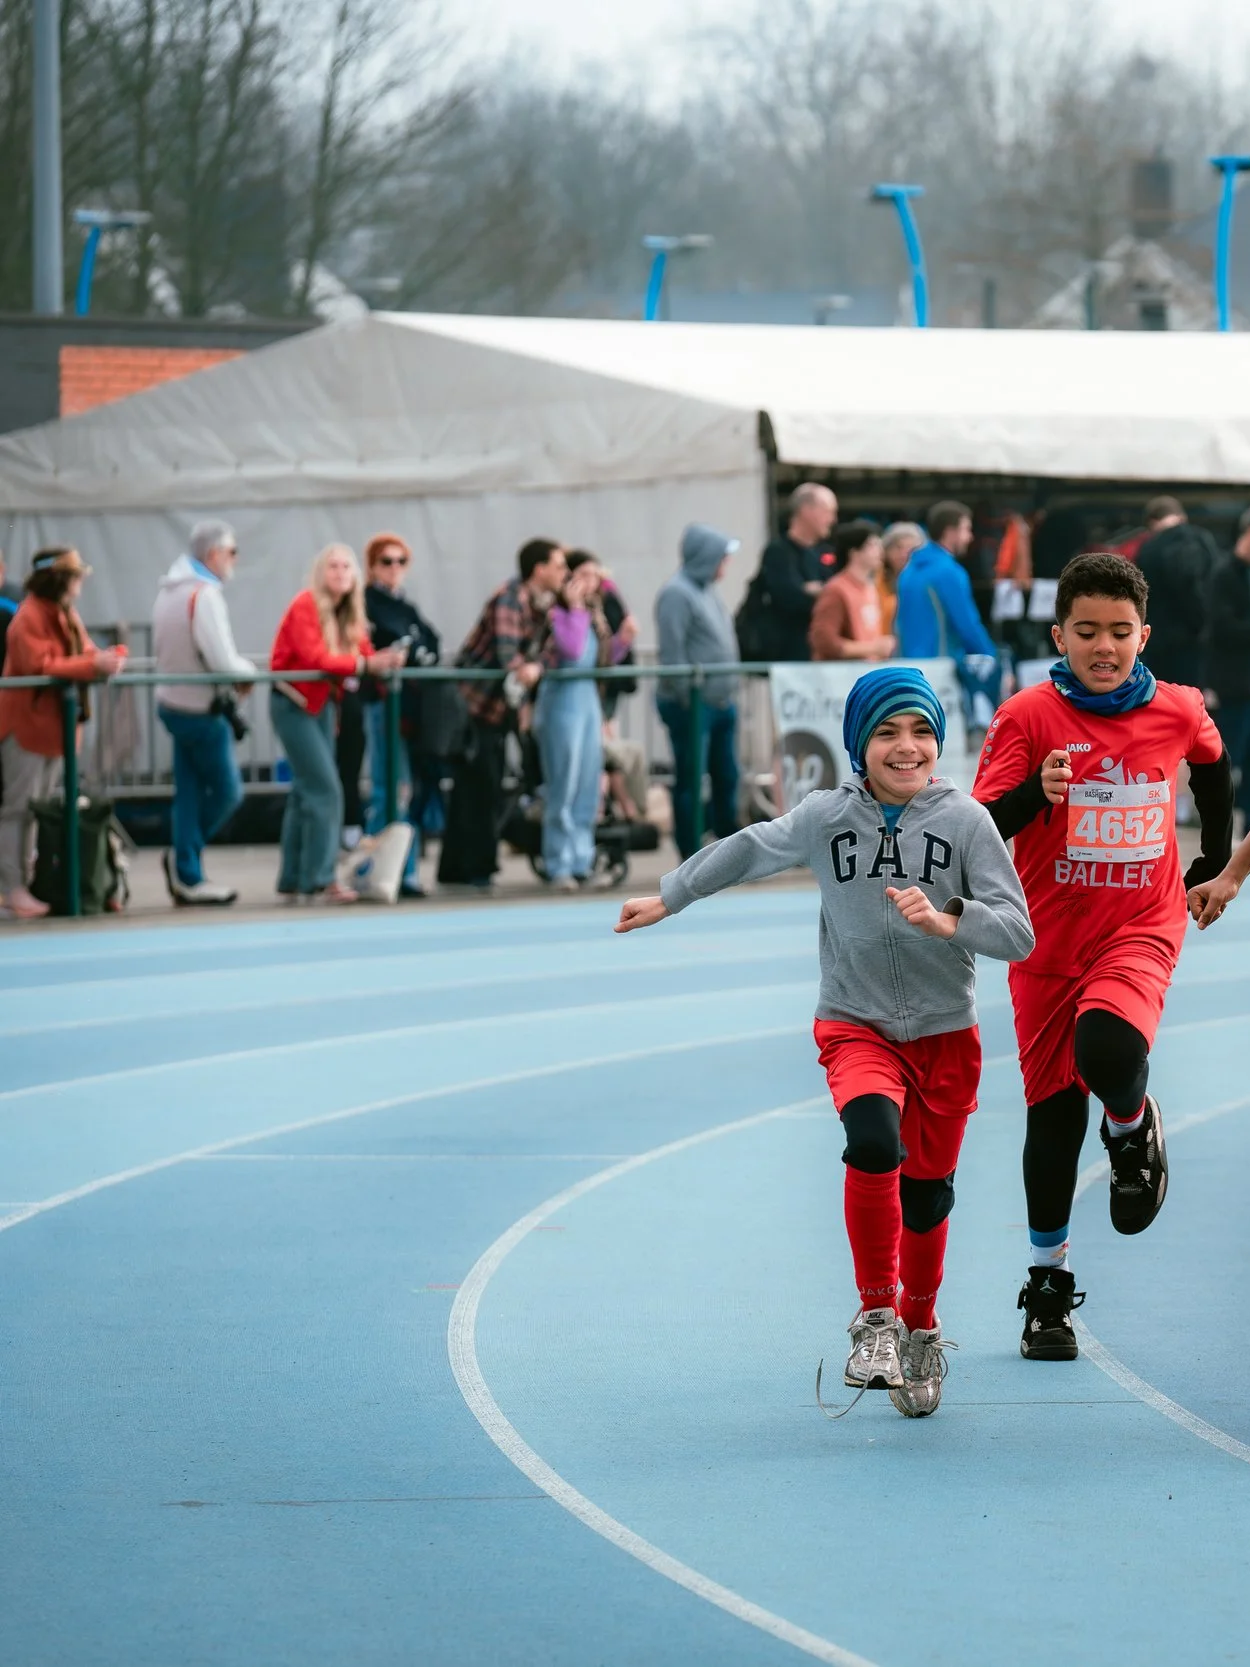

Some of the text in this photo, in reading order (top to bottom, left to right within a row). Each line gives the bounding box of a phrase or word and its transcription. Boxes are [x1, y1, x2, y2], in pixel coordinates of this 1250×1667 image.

[1065, 743, 1092, 753] JAKO
[1147, 789, 1161, 799] 5K
[1074, 807, 1165, 845] 4652
[829, 824, 953, 887] GAP
[1054, 859, 1156, 889] BALLER
[860, 1284, 896, 1297] JAKO
[868, 1311, 884, 1319] NIKE
